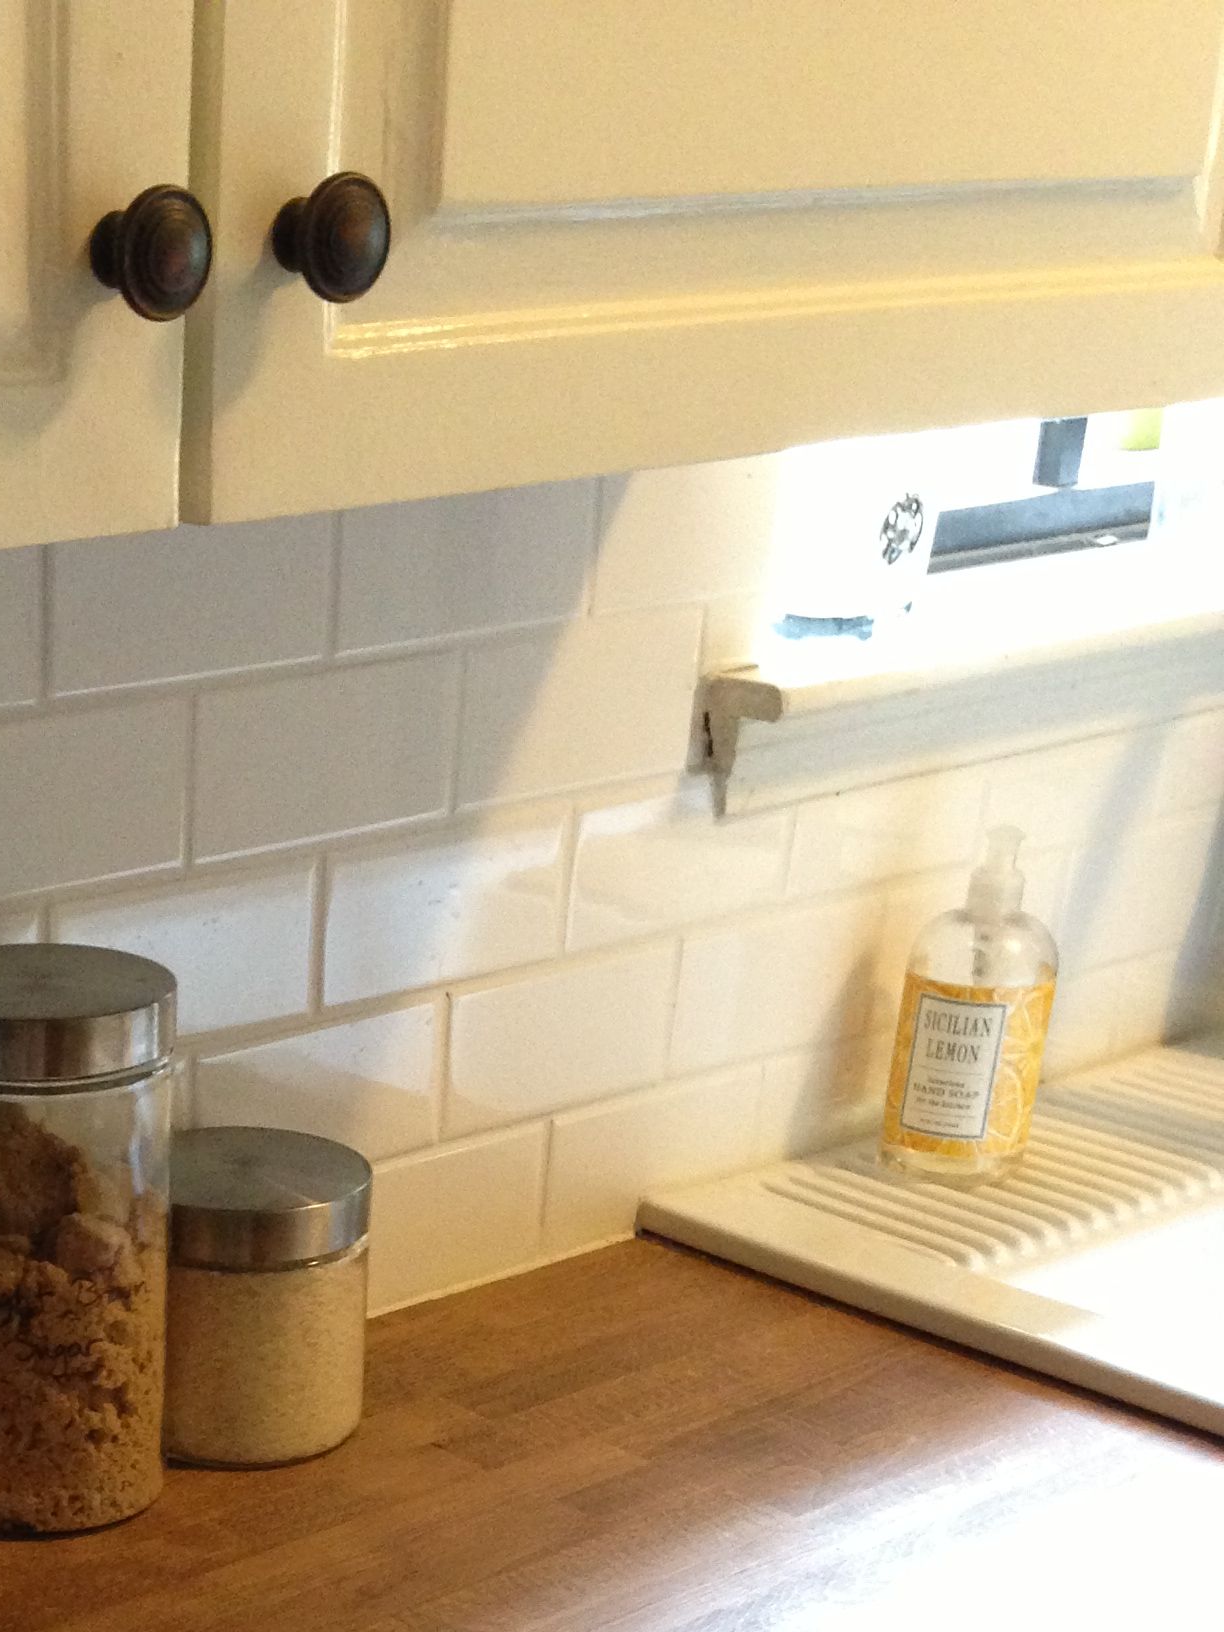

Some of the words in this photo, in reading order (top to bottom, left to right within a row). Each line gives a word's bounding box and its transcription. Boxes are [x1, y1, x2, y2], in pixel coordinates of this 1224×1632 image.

[924, 1009, 993, 1038] SICILIAN
[926, 1038, 981, 1064] LEMON
[913, 1083, 945, 1098] HAND
[948, 1088, 980, 1099] SOAP
